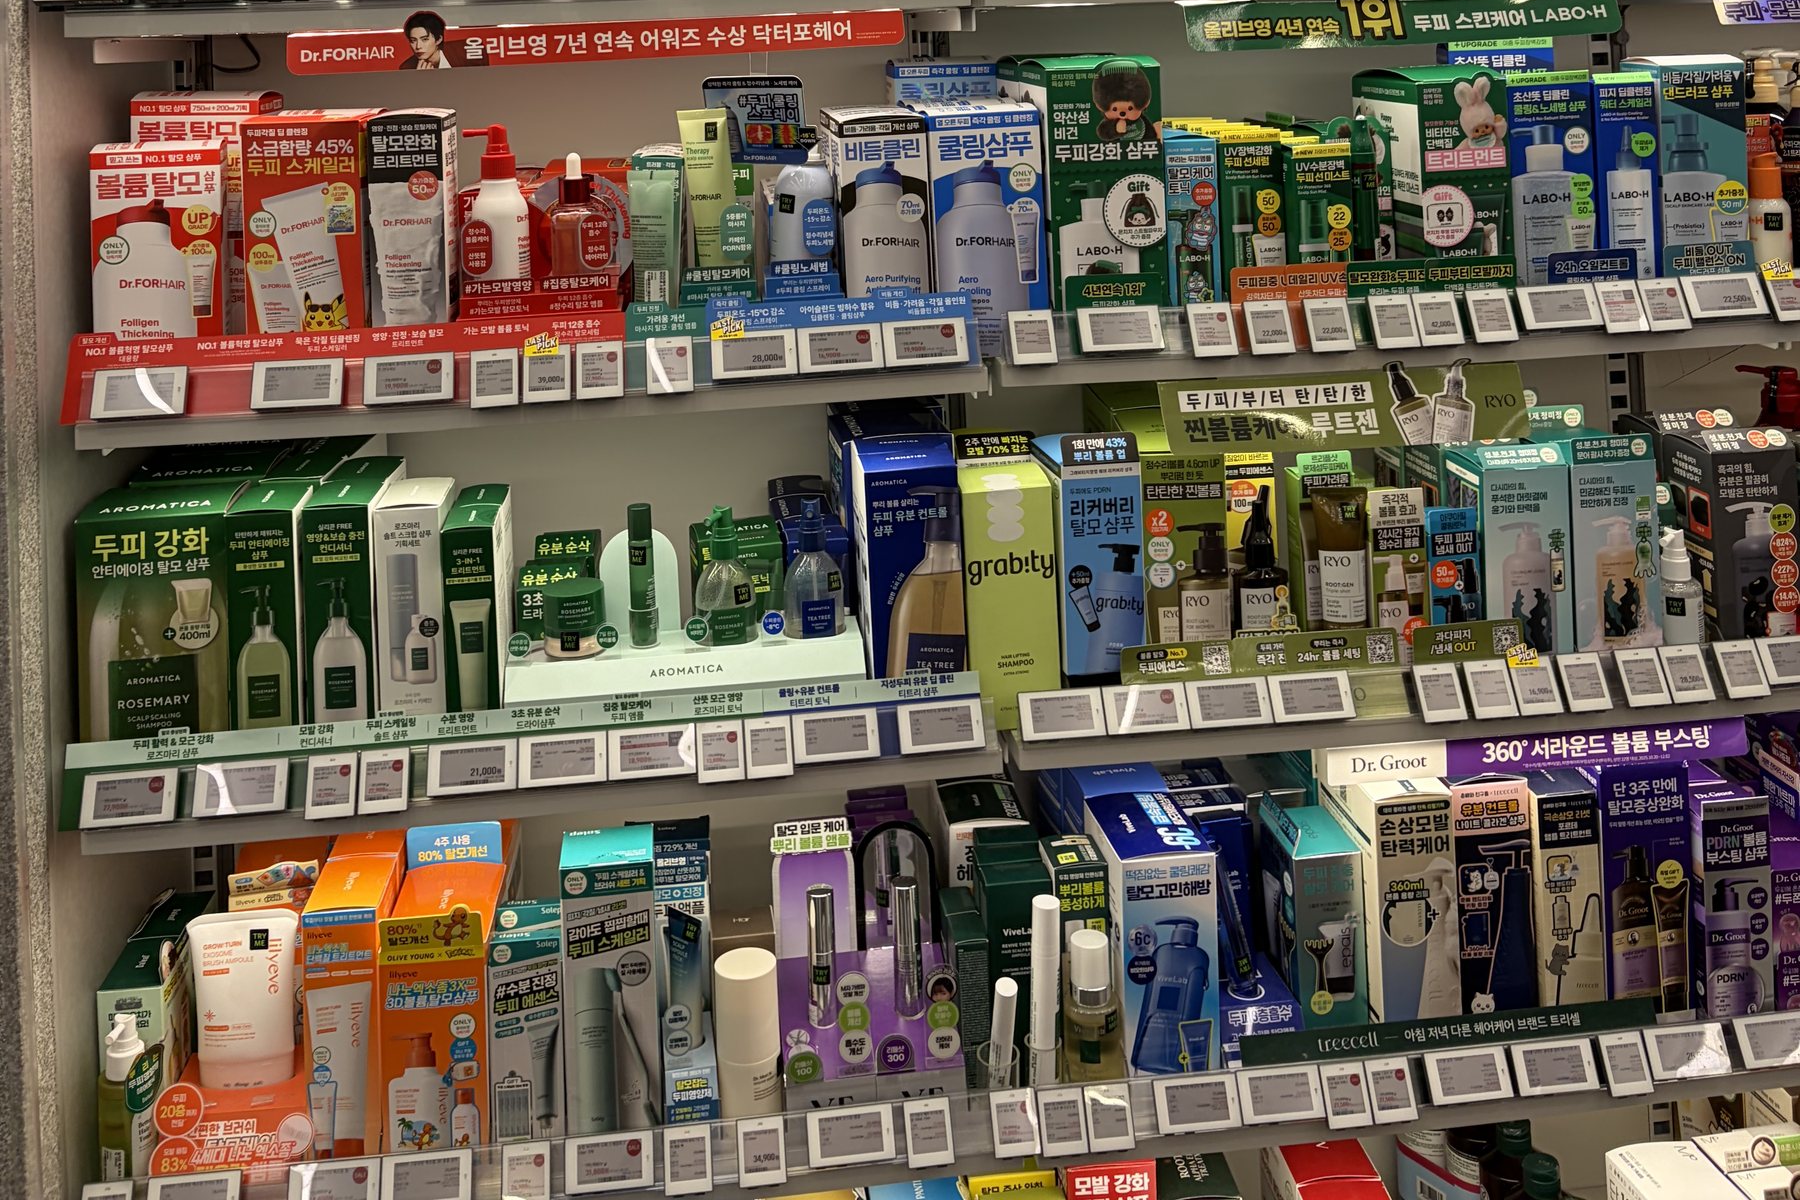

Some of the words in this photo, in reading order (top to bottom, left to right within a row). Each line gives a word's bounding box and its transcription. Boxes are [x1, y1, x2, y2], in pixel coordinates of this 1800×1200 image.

[1204, 20, 1271, 39] 올리브영
[1275, 19, 1303, 37] 4년
[1306, 18, 1339, 35] 연속
[1414, 14, 1449, 31] 두피
[1455, 9, 1527, 28] 스킨케어
[463, 35, 546, 59] 올리브영
[555, 34, 588, 55] 7년
[593, 32, 634, 54] 연속
[639, 28, 700, 51] 어워즈
[706, 25, 747, 48] 수상
[752, 20, 852, 45] 닥터포헤어
[300, 46, 395, 63] Dr.FORHAIR
[1663, 86, 1707, 100] 댄드러프
[1711, 84, 1734, 98] 샴푸
[749, 108, 799, 122] 스프레이
[1053, 111, 1089, 125] 약산성
[1054, 127, 1078, 140] 비건
[247, 140, 311, 157] 소금함량
[316, 139, 354, 155] 45%
[372, 135, 437, 151] 탈모완화
[845, 138, 920, 161] 비듬클린
[373, 152, 438, 168] 트리트먼트
[1055, 144, 1122, 163] 두피강화
[1126, 142, 1159, 160] 샴푸
[1427, 151, 1506, 168] 트리트먼트
[247, 159, 281, 176] 두피
[287, 157, 355, 174] 스케일러
[96, 172, 202, 200] 볼륨탈모
[862, 236, 920, 248] Dr.FORHAIR
[1685, 246, 1703, 256] 비듬
[1707, 245, 1732, 256] OUT
[775, 261, 828, 274] #쿨링노세범
[1674, 258, 1693, 269] 두피
[1696, 256, 1724, 267] 밸런스
[1727, 254, 1745, 265] ON
[119, 278, 185, 289] Dr.FORHAIR
[465, 280, 532, 293] #가는모발영양
[543, 275, 609, 289] #집중탈모케어
[121, 318, 159, 329] Folligen
[121, 329, 174, 339] Thickening
[1186, 390, 1285, 410] 두/피/부/터
[1295, 384, 1367, 404] 탄/탄/한
[1484, 394, 1516, 407] RYO
[1311, 408, 1380, 438] 루트젠
[99, 499, 212, 514] AROMATICA
[1070, 499, 1134, 516] 리커버리
[1070, 519, 1102, 535] 탈모
[1105, 517, 1134, 533] 샴푸
[92, 532, 147, 561] 두피
[154, 526, 209, 556] 강화
[91, 562, 154, 579] 안티에이징
[157, 561, 183, 575] 탈모
[187, 559, 211, 573] 샴푸
[1324, 555, 1351, 567] RYO
[1246, 593, 1271, 605] RYO
[179, 630, 211, 640] 400ml
[1434, 628, 1471, 640] 과다피지
[650, 664, 723, 678] AROMATICA
[127, 674, 180, 686] AROMATICA
[118, 695, 190, 710] ROSEMARY
[1482, 741, 1528, 762] 360°
[1531, 737, 1607, 759] 서라운드
[1611, 733, 1650, 754] 볼륨
[1654, 727, 1709, 751] 부스팅
[1352, 757, 1375, 773] Dr.
[1379, 754, 1427, 771] Groot
[1613, 781, 1627, 797] 단
[1630, 781, 1649, 796] 3주
[1653, 778, 1677, 795] 만에
[1608, 795, 1684, 814] 탈모증상완화
[1379, 814, 1450, 836] 손상모발
[418, 850, 441, 861] 80%
[444, 846, 488, 859] 탈모개선
[1380, 836, 1450, 857] 탄력케어
[1127, 881, 1211, 901] 탈모고민해방
[387, 953, 409, 961] OLIVE
[411, 951, 434, 959] YOUNG
[268, 938, 281, 995] lilyeve
[1404, 1025, 1426, 1041] 아침
[1429, 1024, 1449, 1039] 저녁
[1451, 1022, 1471, 1037] 다른
[1474, 1019, 1514, 1035] 헤어케어
[1517, 1016, 1547, 1032] 브랜드
[1550, 1012, 1580, 1027] 트리셀
[1318, 1032, 1379, 1050] treecell
[1074, 1177, 1109, 1194] 모발
[1112, 1173, 1149, 1192] 강화
